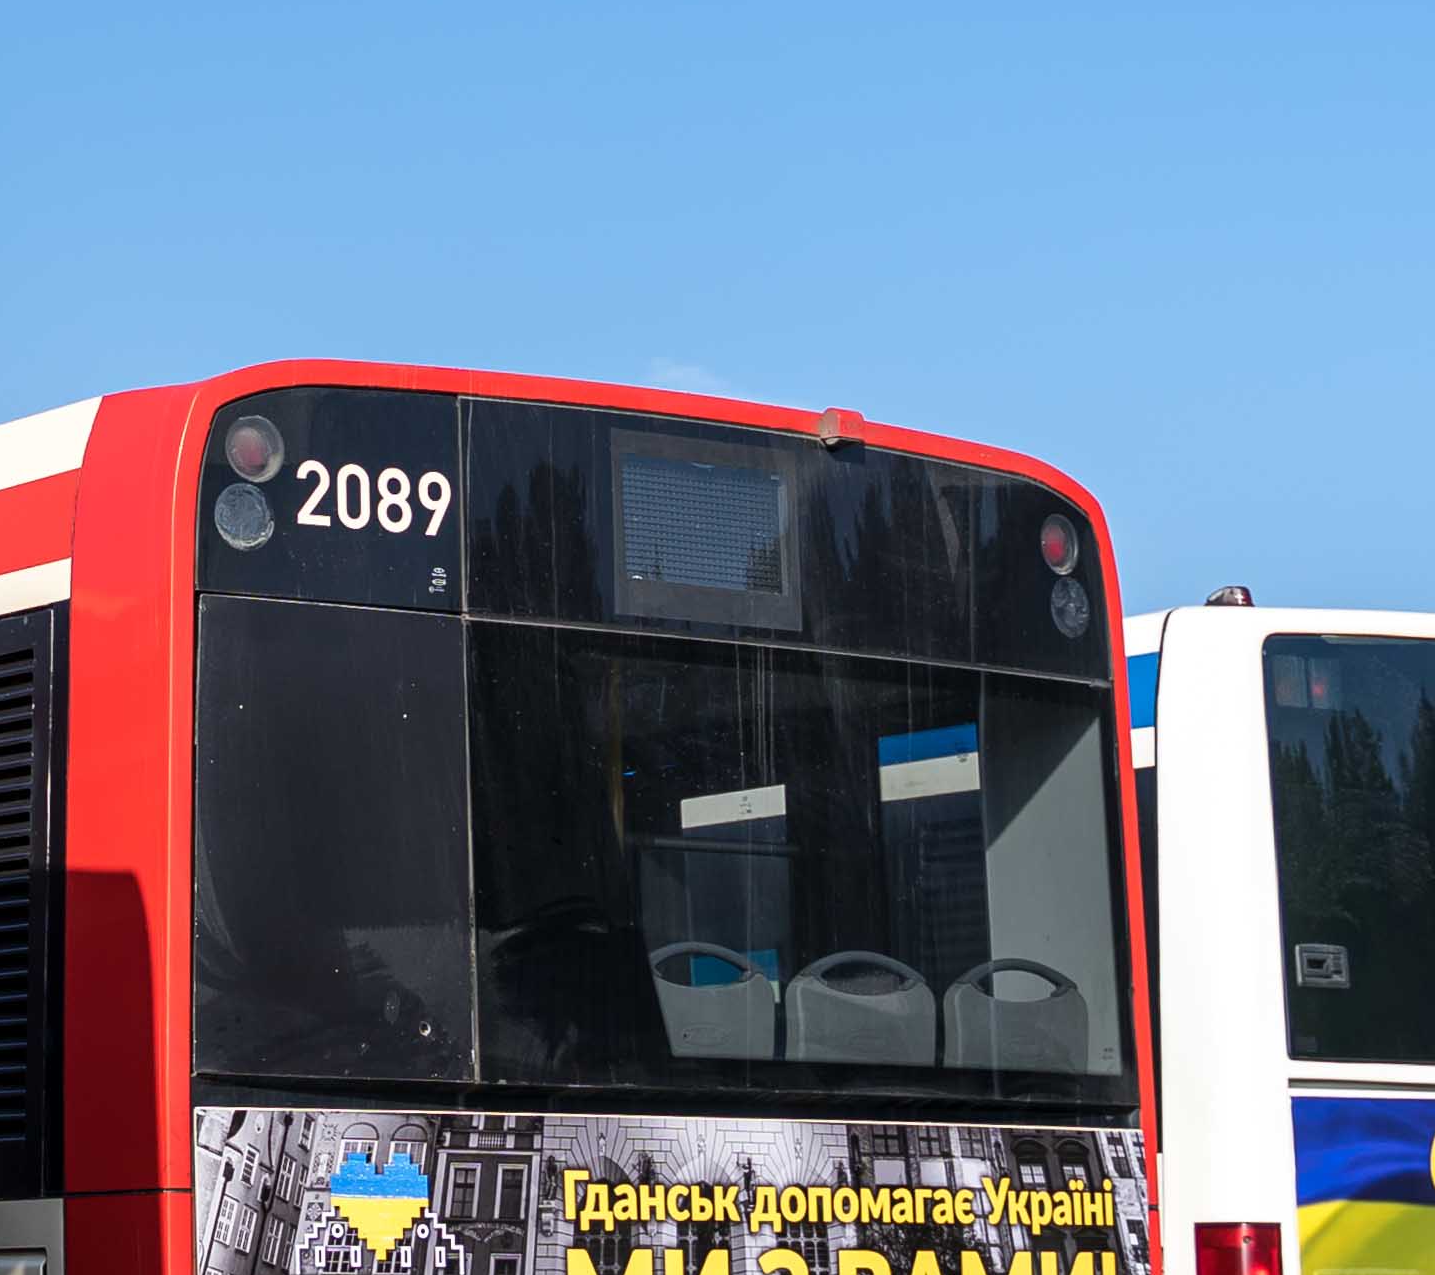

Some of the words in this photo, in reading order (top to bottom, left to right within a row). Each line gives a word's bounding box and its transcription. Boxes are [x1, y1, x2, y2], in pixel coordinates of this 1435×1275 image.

[296, 460, 452, 536] 2089
[563, 1169, 741, 1232] Гданськ
[748, 1186, 978, 1233] допомагає
[982, 1177, 1114, 1236] Україні
